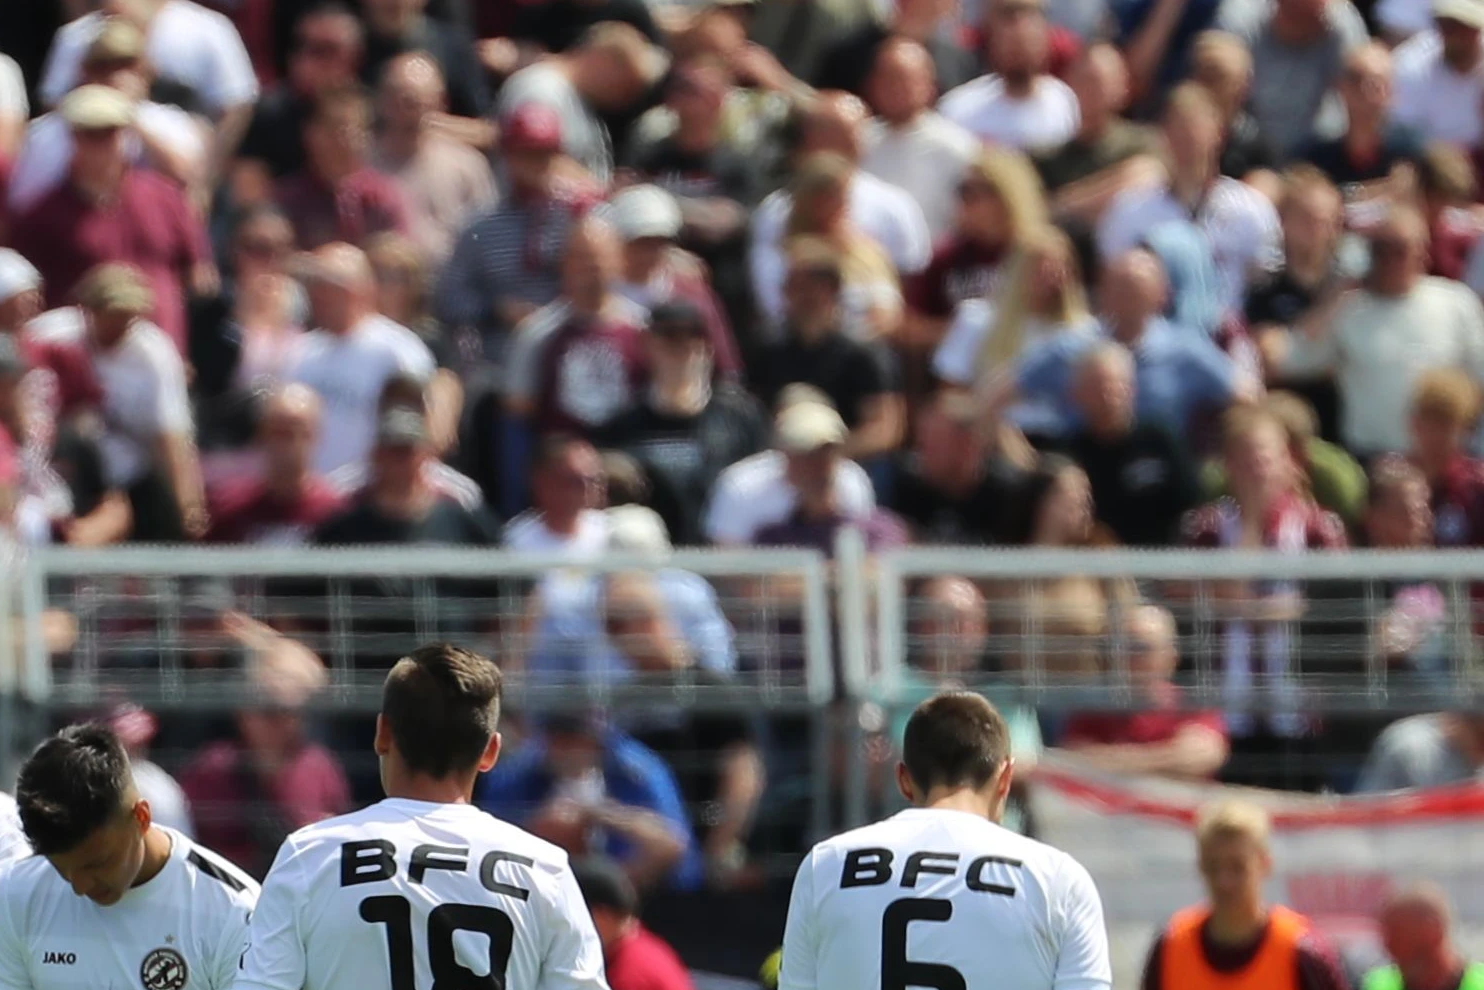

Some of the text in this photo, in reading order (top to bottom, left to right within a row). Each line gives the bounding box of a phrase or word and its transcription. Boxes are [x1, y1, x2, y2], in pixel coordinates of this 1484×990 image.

[341, 839, 534, 901] BFC
[840, 847, 1022, 898] BFC
[42, 952, 76, 964] JAKO
